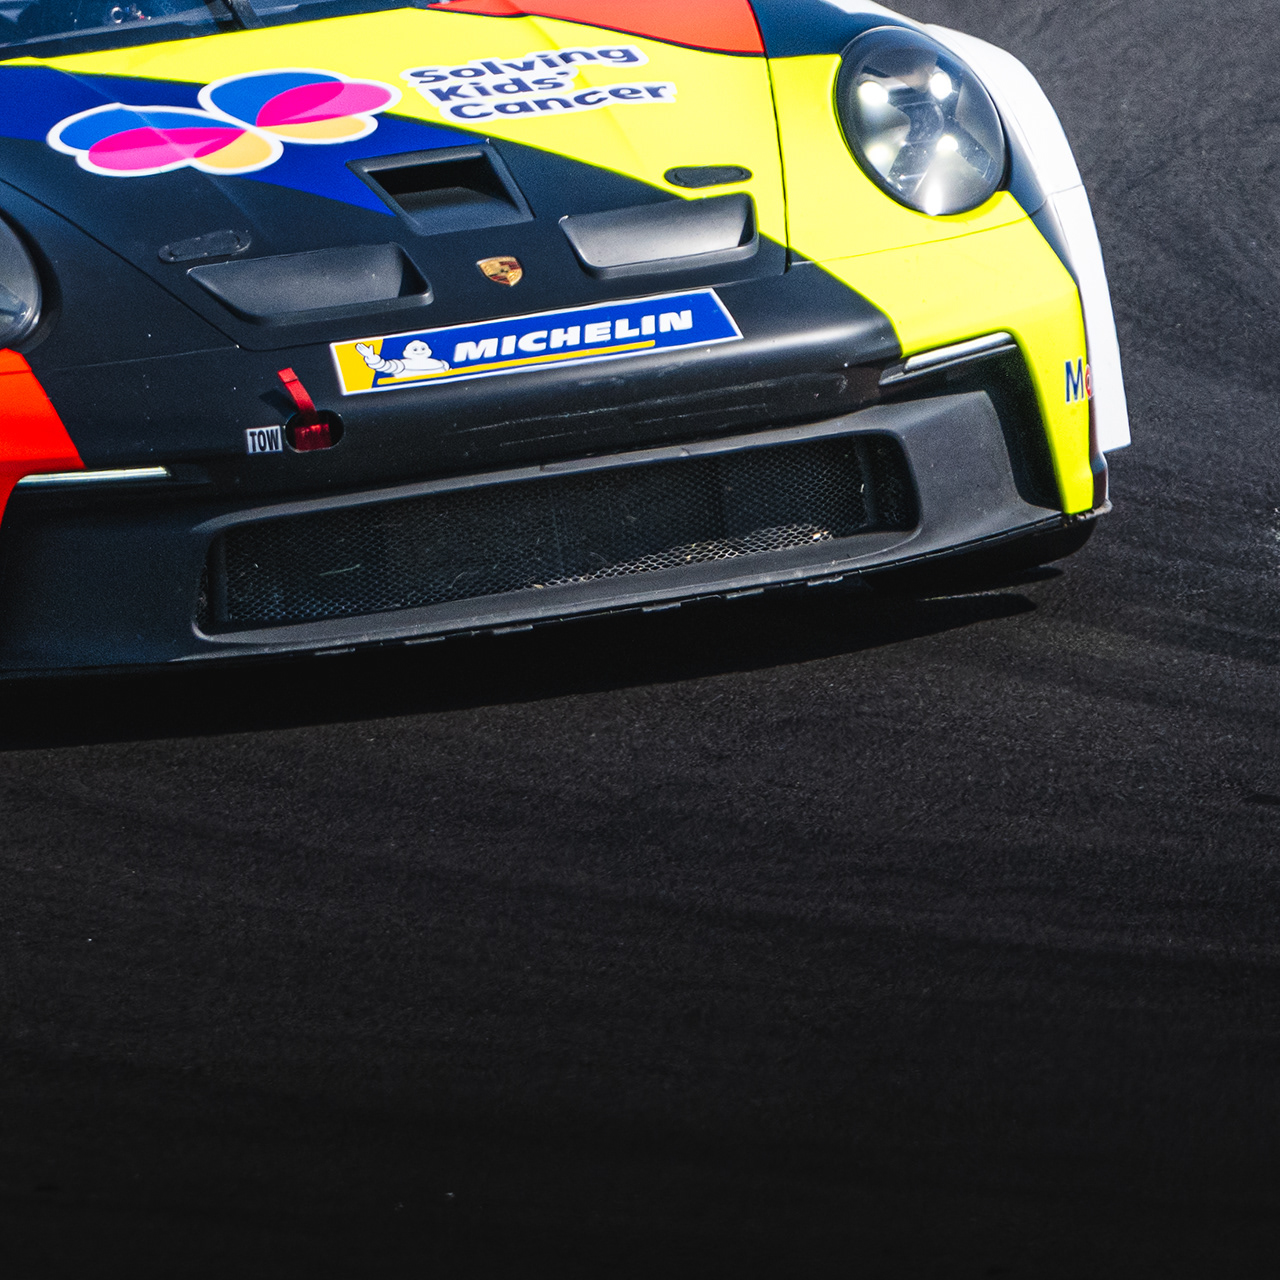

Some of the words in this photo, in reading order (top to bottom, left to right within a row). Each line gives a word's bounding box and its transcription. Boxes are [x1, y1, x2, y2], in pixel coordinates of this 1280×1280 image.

[408, 45, 640, 86] Solving
[450, 79, 669, 121] Cancer
[453, 308, 694, 363] MICHELIN
[248, 428, 280, 454] TOW
